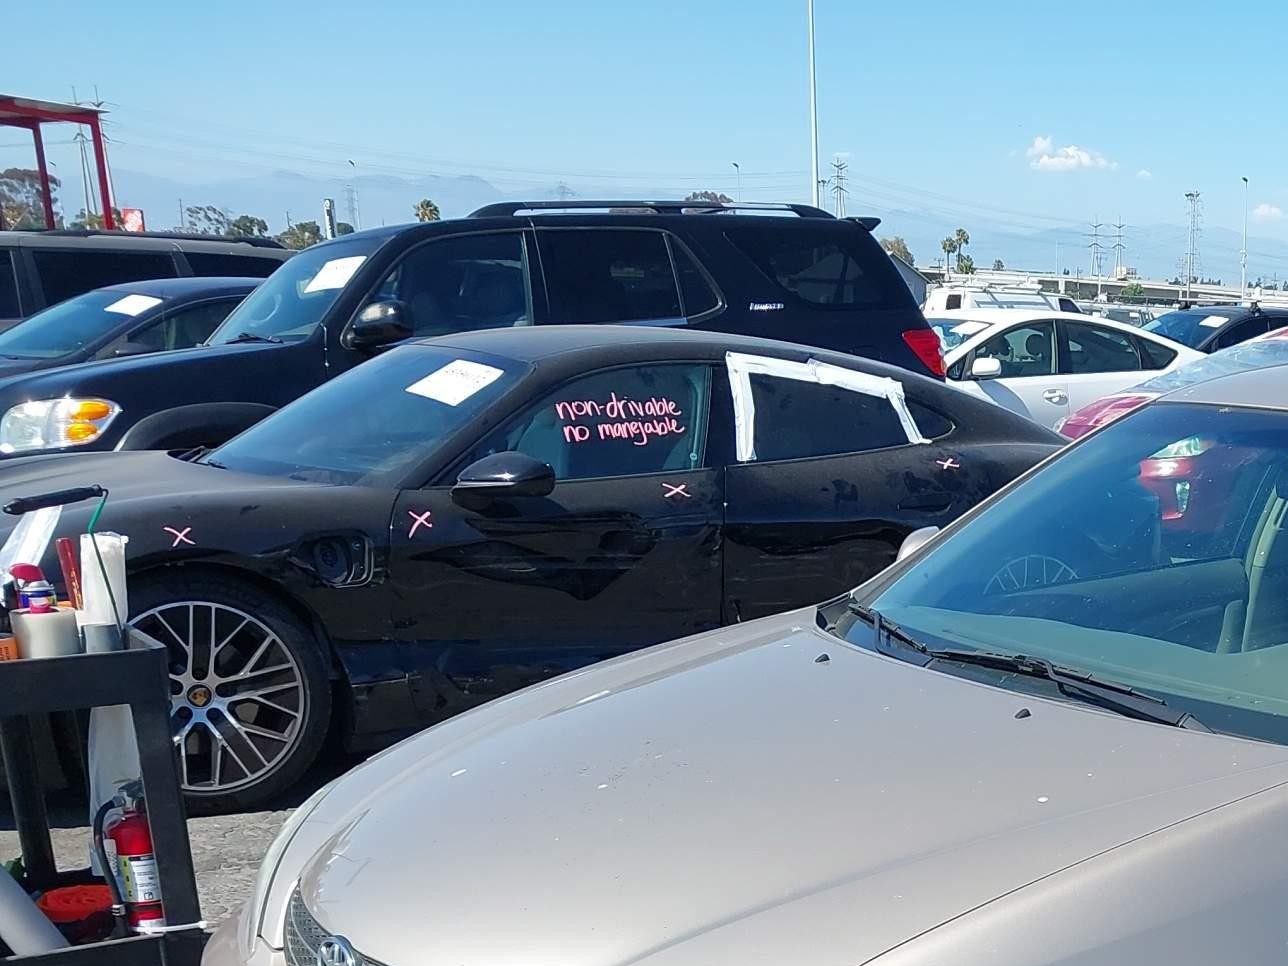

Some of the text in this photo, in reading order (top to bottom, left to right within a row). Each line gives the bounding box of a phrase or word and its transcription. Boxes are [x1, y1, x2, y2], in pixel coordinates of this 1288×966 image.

[556, 392, 682, 420] non-drivable
[563, 417, 685, 446] no manejable
